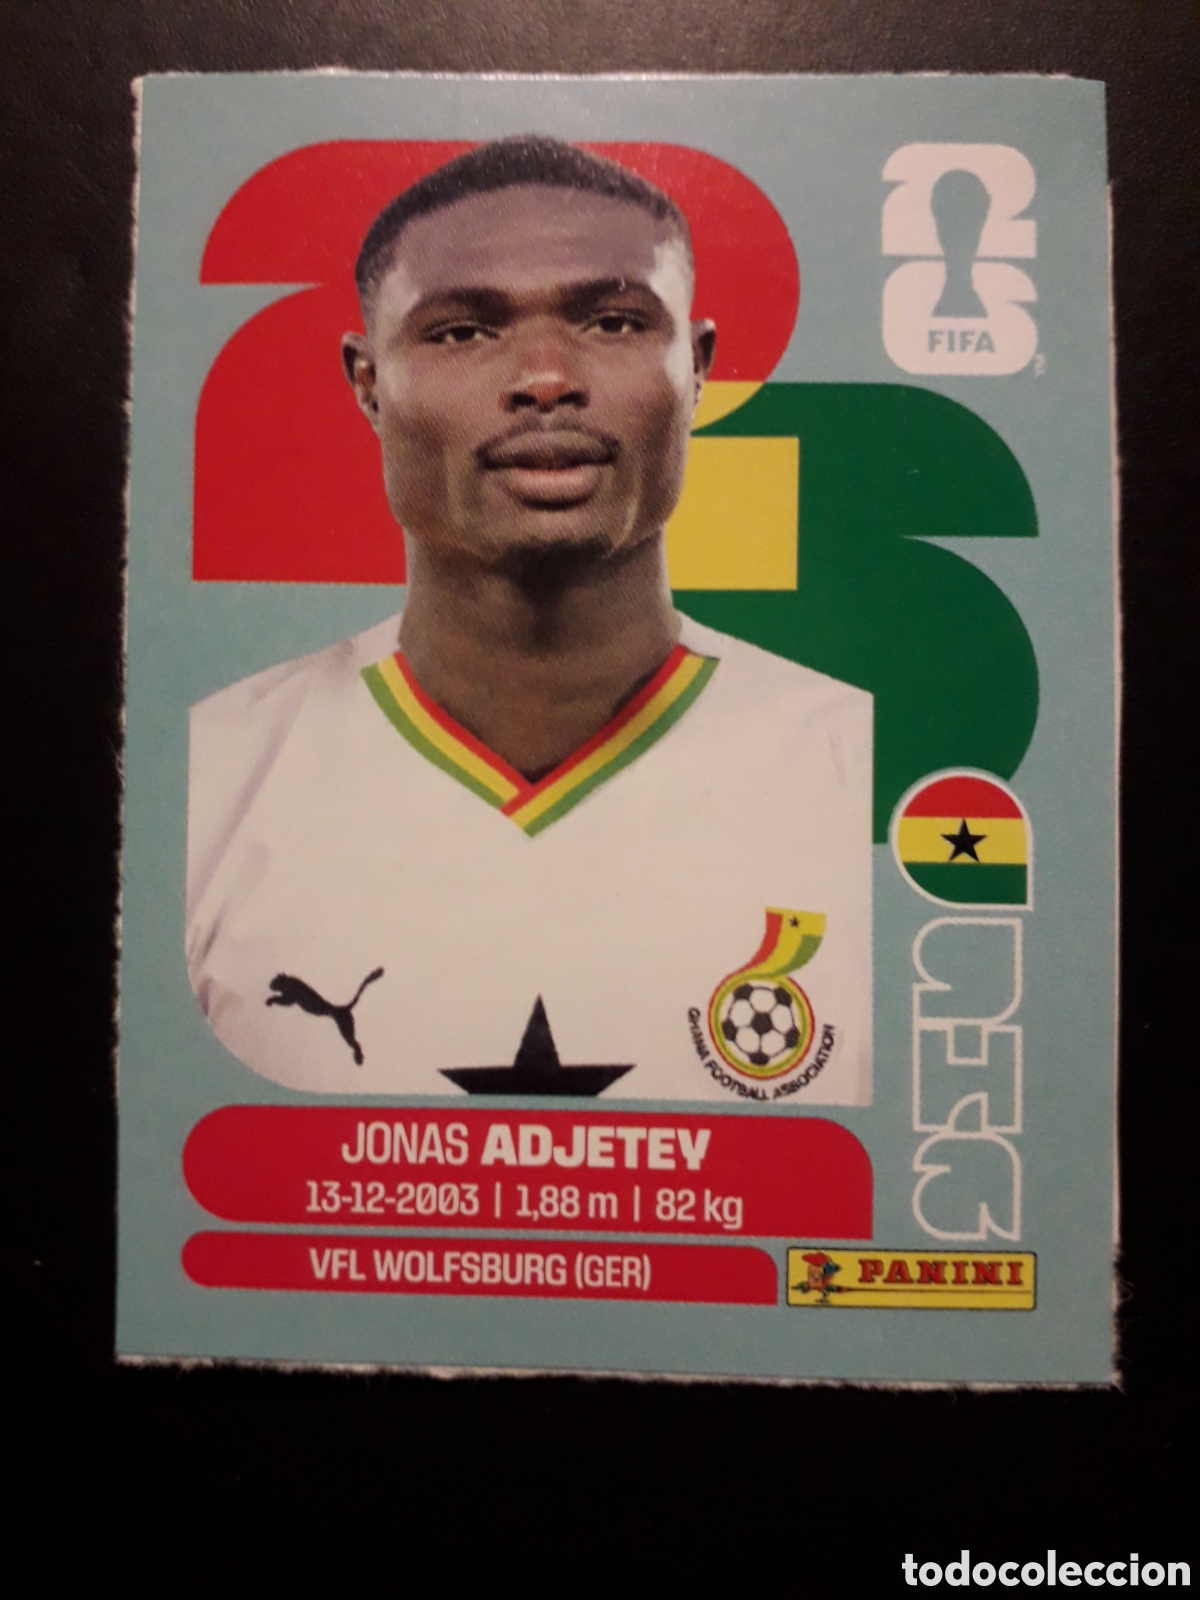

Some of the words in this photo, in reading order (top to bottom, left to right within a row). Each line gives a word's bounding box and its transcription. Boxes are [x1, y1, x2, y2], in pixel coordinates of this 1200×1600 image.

[927, 329, 995, 354] FIFA
[687, 1007, 711, 1062] GHANA
[704, 1059, 770, 1101] FOOTBALL
[772, 1023, 837, 1100] ASSOCIATION
[341, 1121, 469, 1165] JONAS
[480, 1123, 711, 1171] ADJETEY
[306, 1181, 480, 1215] 13-12-2003
[516, 1185, 580, 1222] 1,88
[588, 1192, 618, 1219] m
[655, 1188, 696, 1221] 82
[704, 1189, 744, 1230] kg
[310, 1248, 366, 1280] VFL
[373, 1250, 567, 1286] WOLFSBURG
[575, 1252, 652, 1291] (GER)
[858, 1258, 1024, 1286] PANINI
